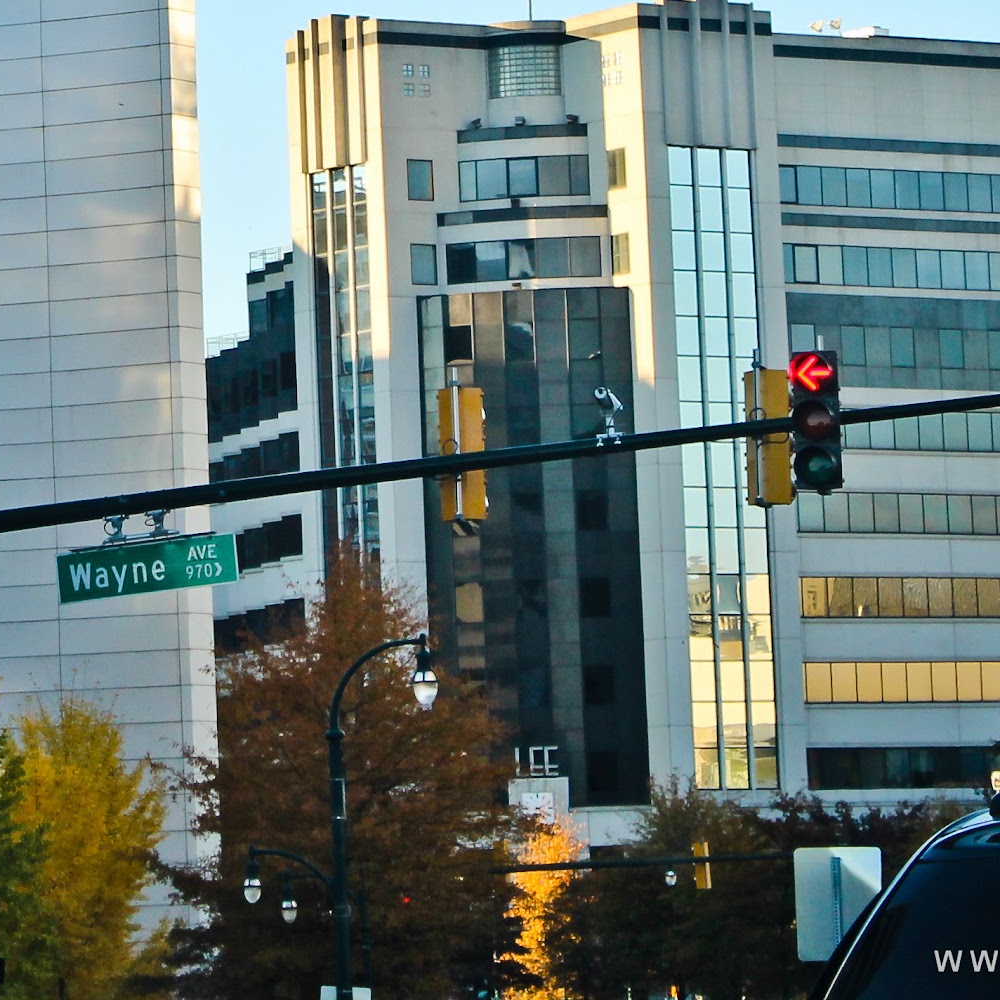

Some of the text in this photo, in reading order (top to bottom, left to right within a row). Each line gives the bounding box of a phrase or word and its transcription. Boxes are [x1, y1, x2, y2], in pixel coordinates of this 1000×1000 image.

[187, 543, 218, 562] AVE
[69, 559, 166, 593] Wayne
[185, 563, 213, 580] 970
